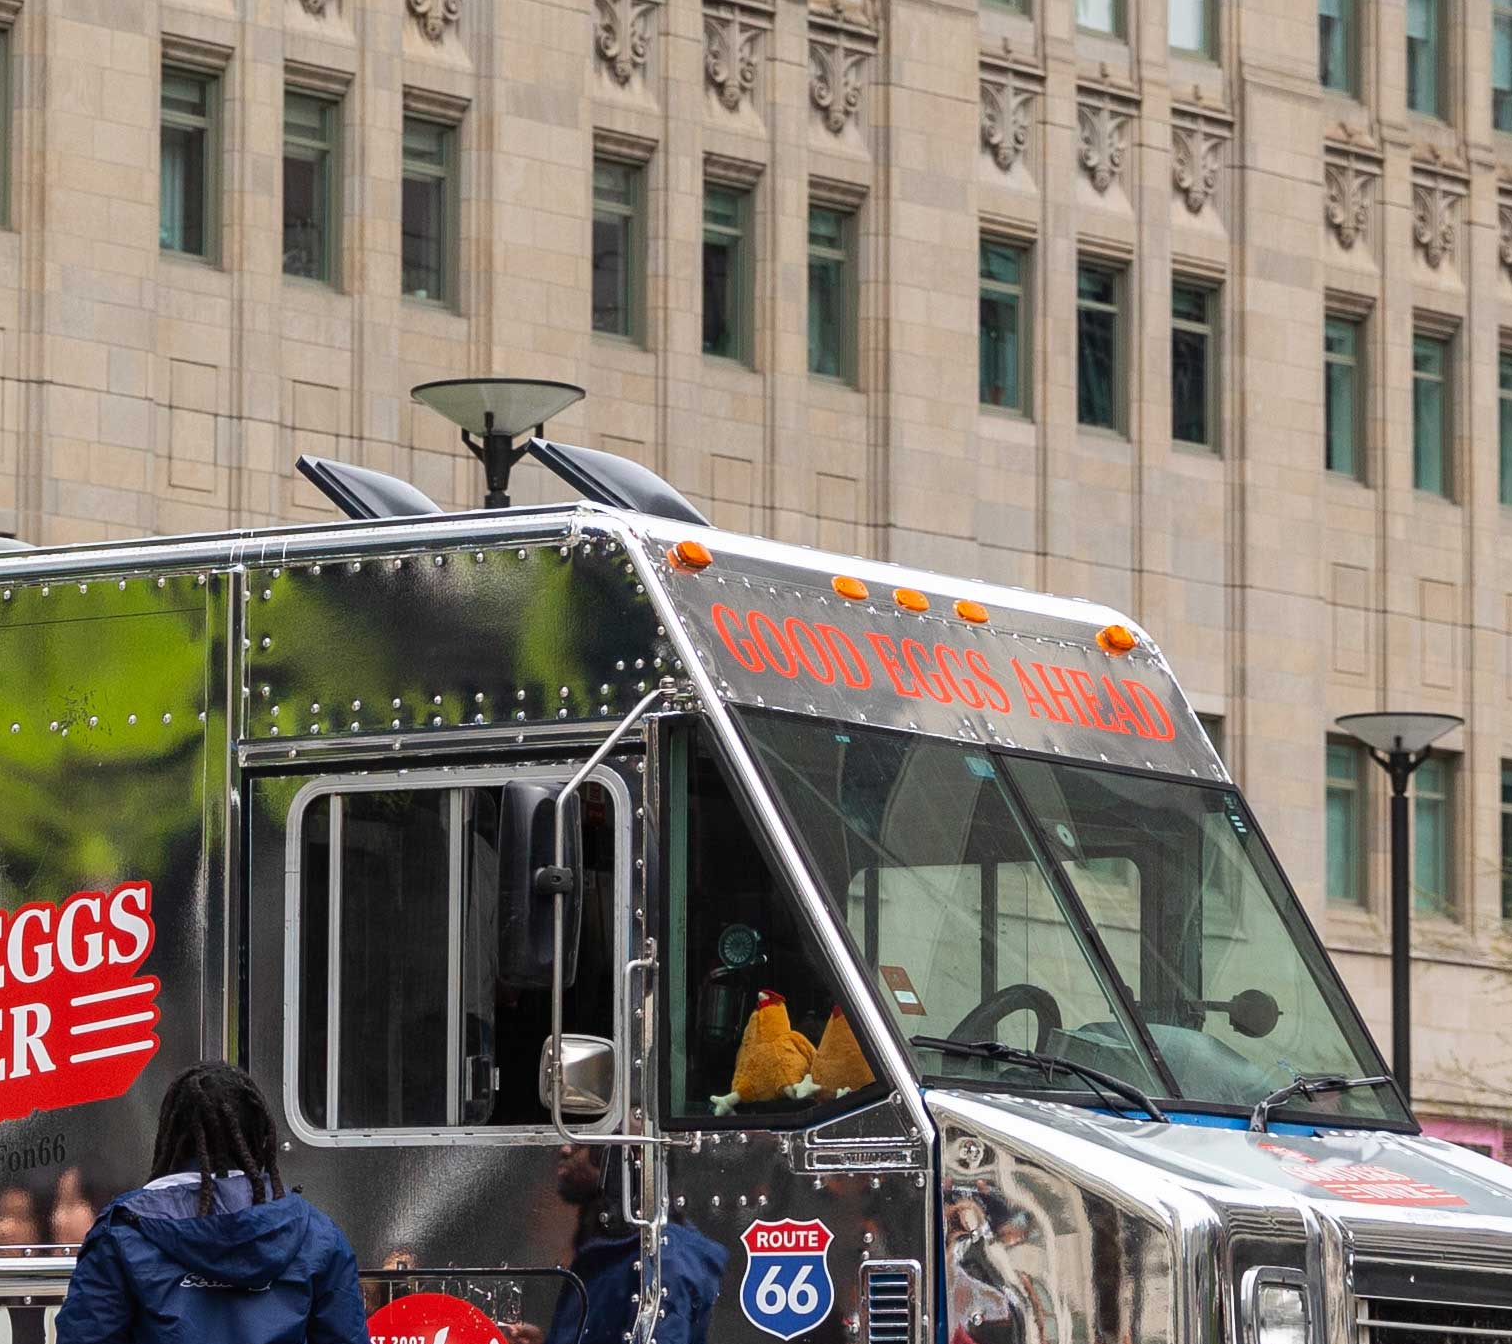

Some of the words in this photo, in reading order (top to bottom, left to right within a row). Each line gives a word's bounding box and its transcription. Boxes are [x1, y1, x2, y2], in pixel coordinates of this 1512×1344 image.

[711, 603, 871, 689] GOOD
[865, 632, 1011, 714] EGGS
[1010, 657, 1174, 742] AHEAD
[756, 1231, 818, 1247] ROUTE
[756, 1265, 818, 1315] 66
